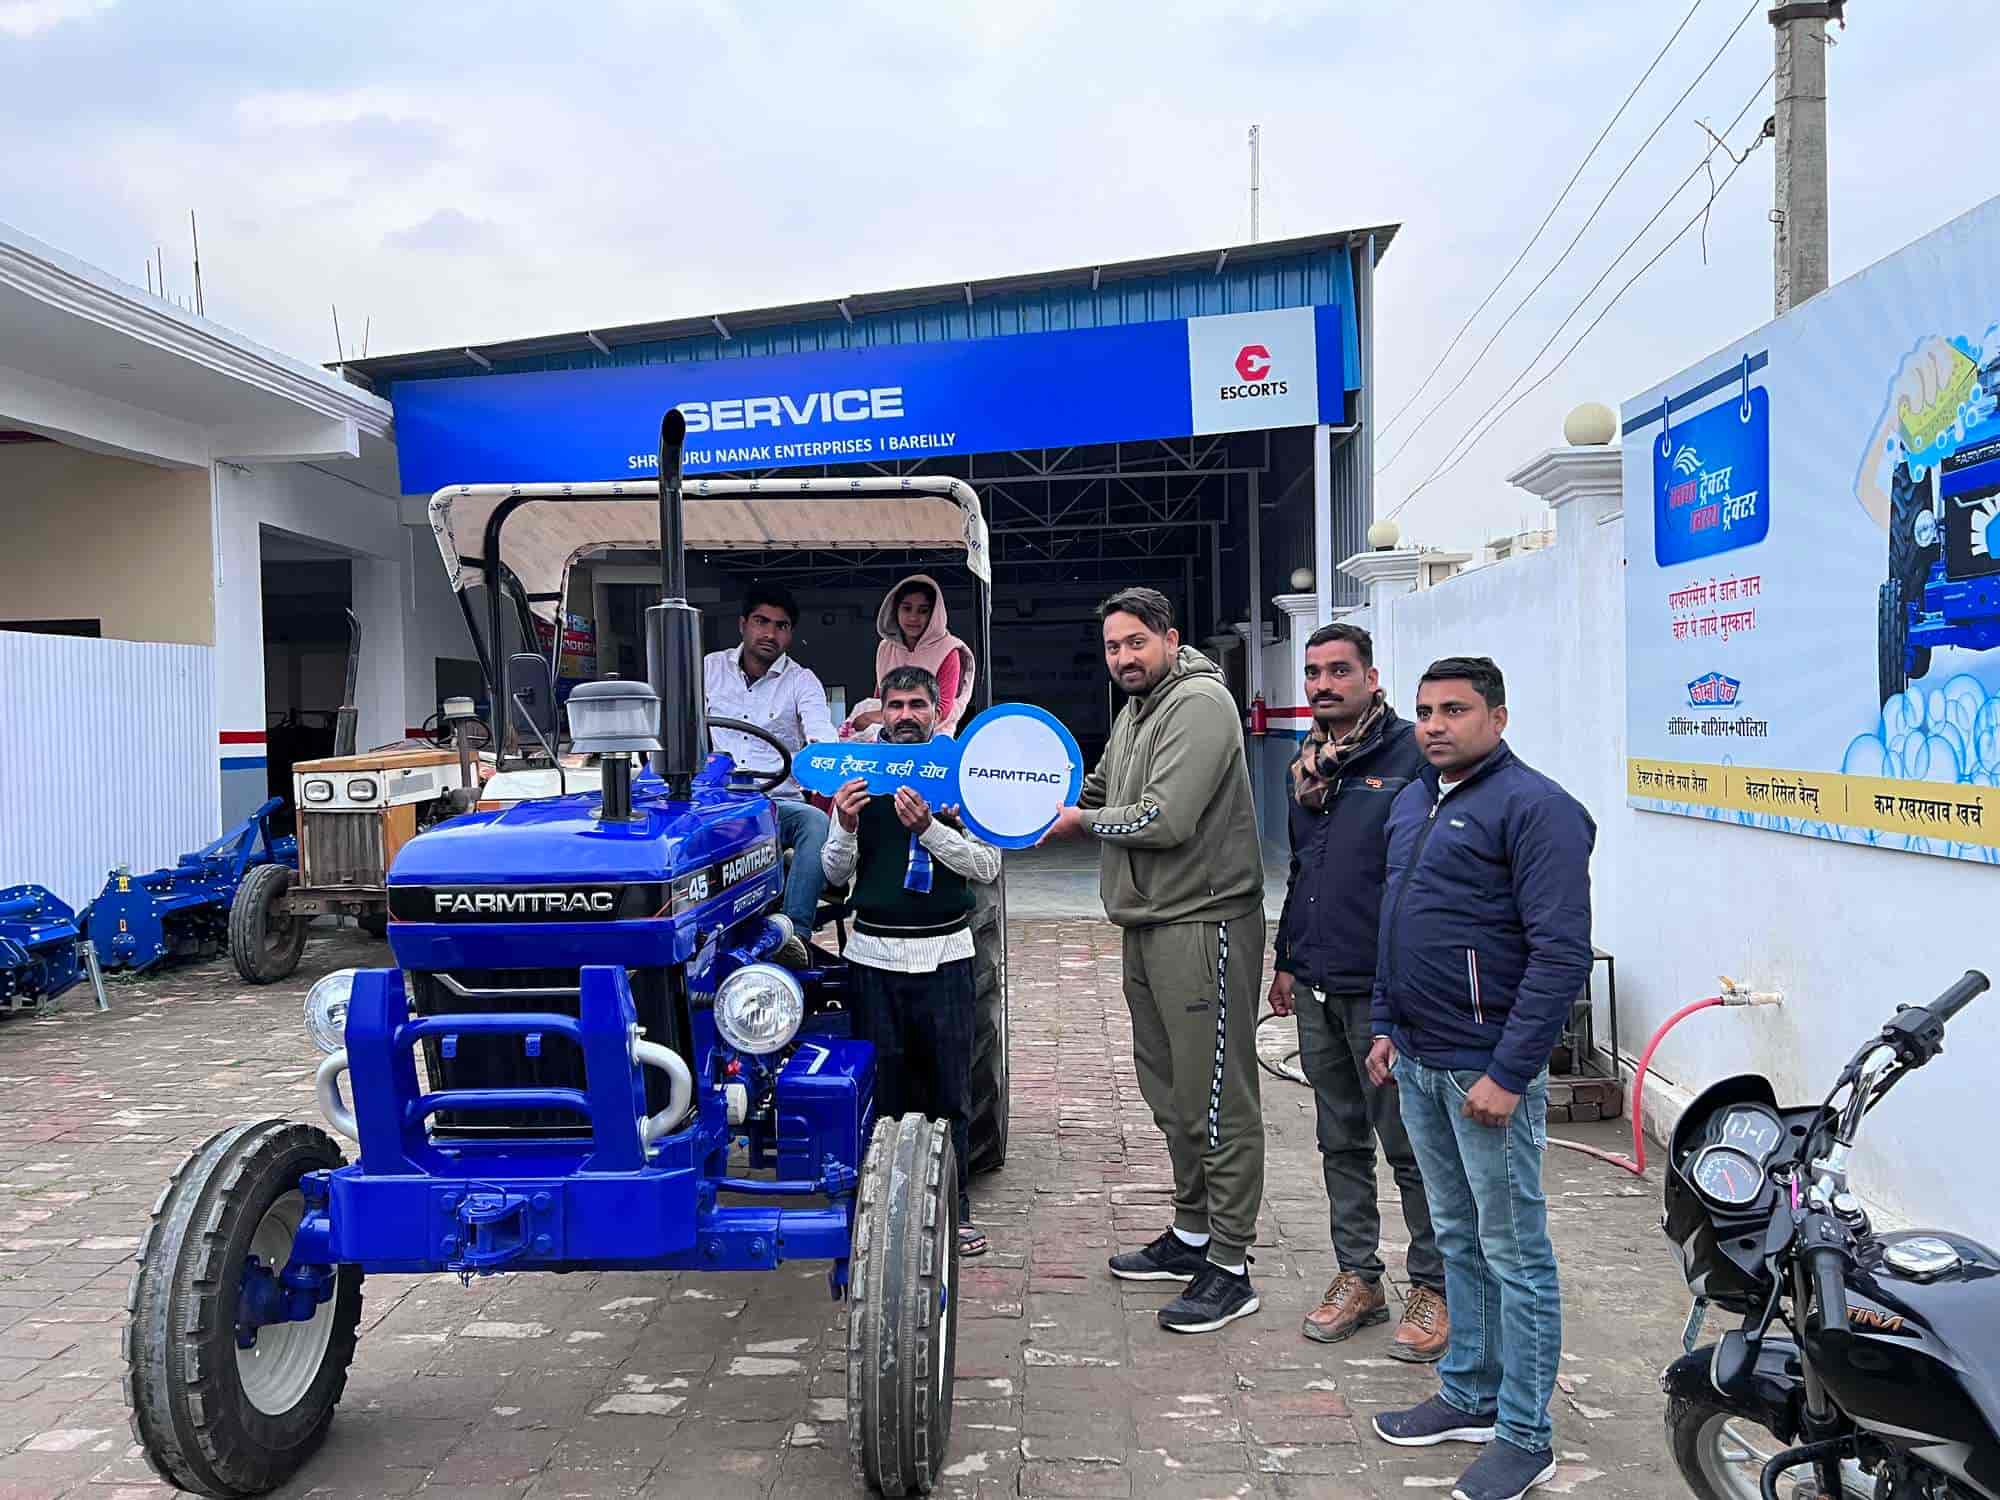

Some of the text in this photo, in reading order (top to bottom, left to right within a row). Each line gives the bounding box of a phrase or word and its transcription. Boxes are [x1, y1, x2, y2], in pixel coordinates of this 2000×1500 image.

[1220, 382, 1288, 400] ESCORTS
[675, 386, 904, 433] SERVICE
[628, 454, 659, 469] SHR
[681, 450, 711, 465] URU
[715, 446, 771, 464] NANAK
[775, 438, 872, 459] ENTERPRISES
[889, 432, 956, 450] BAREILLY
[968, 766, 1061, 785] FARMTRAC
[1745, 776, 1769, 803] बेहतर
[1873, 794, 1984, 827] कम रखरखाव खर्च
[722, 846, 776, 887] FARMTRAC
[688, 873, 709, 900] 45
[434, 892, 615, 913] FARMTRAC
